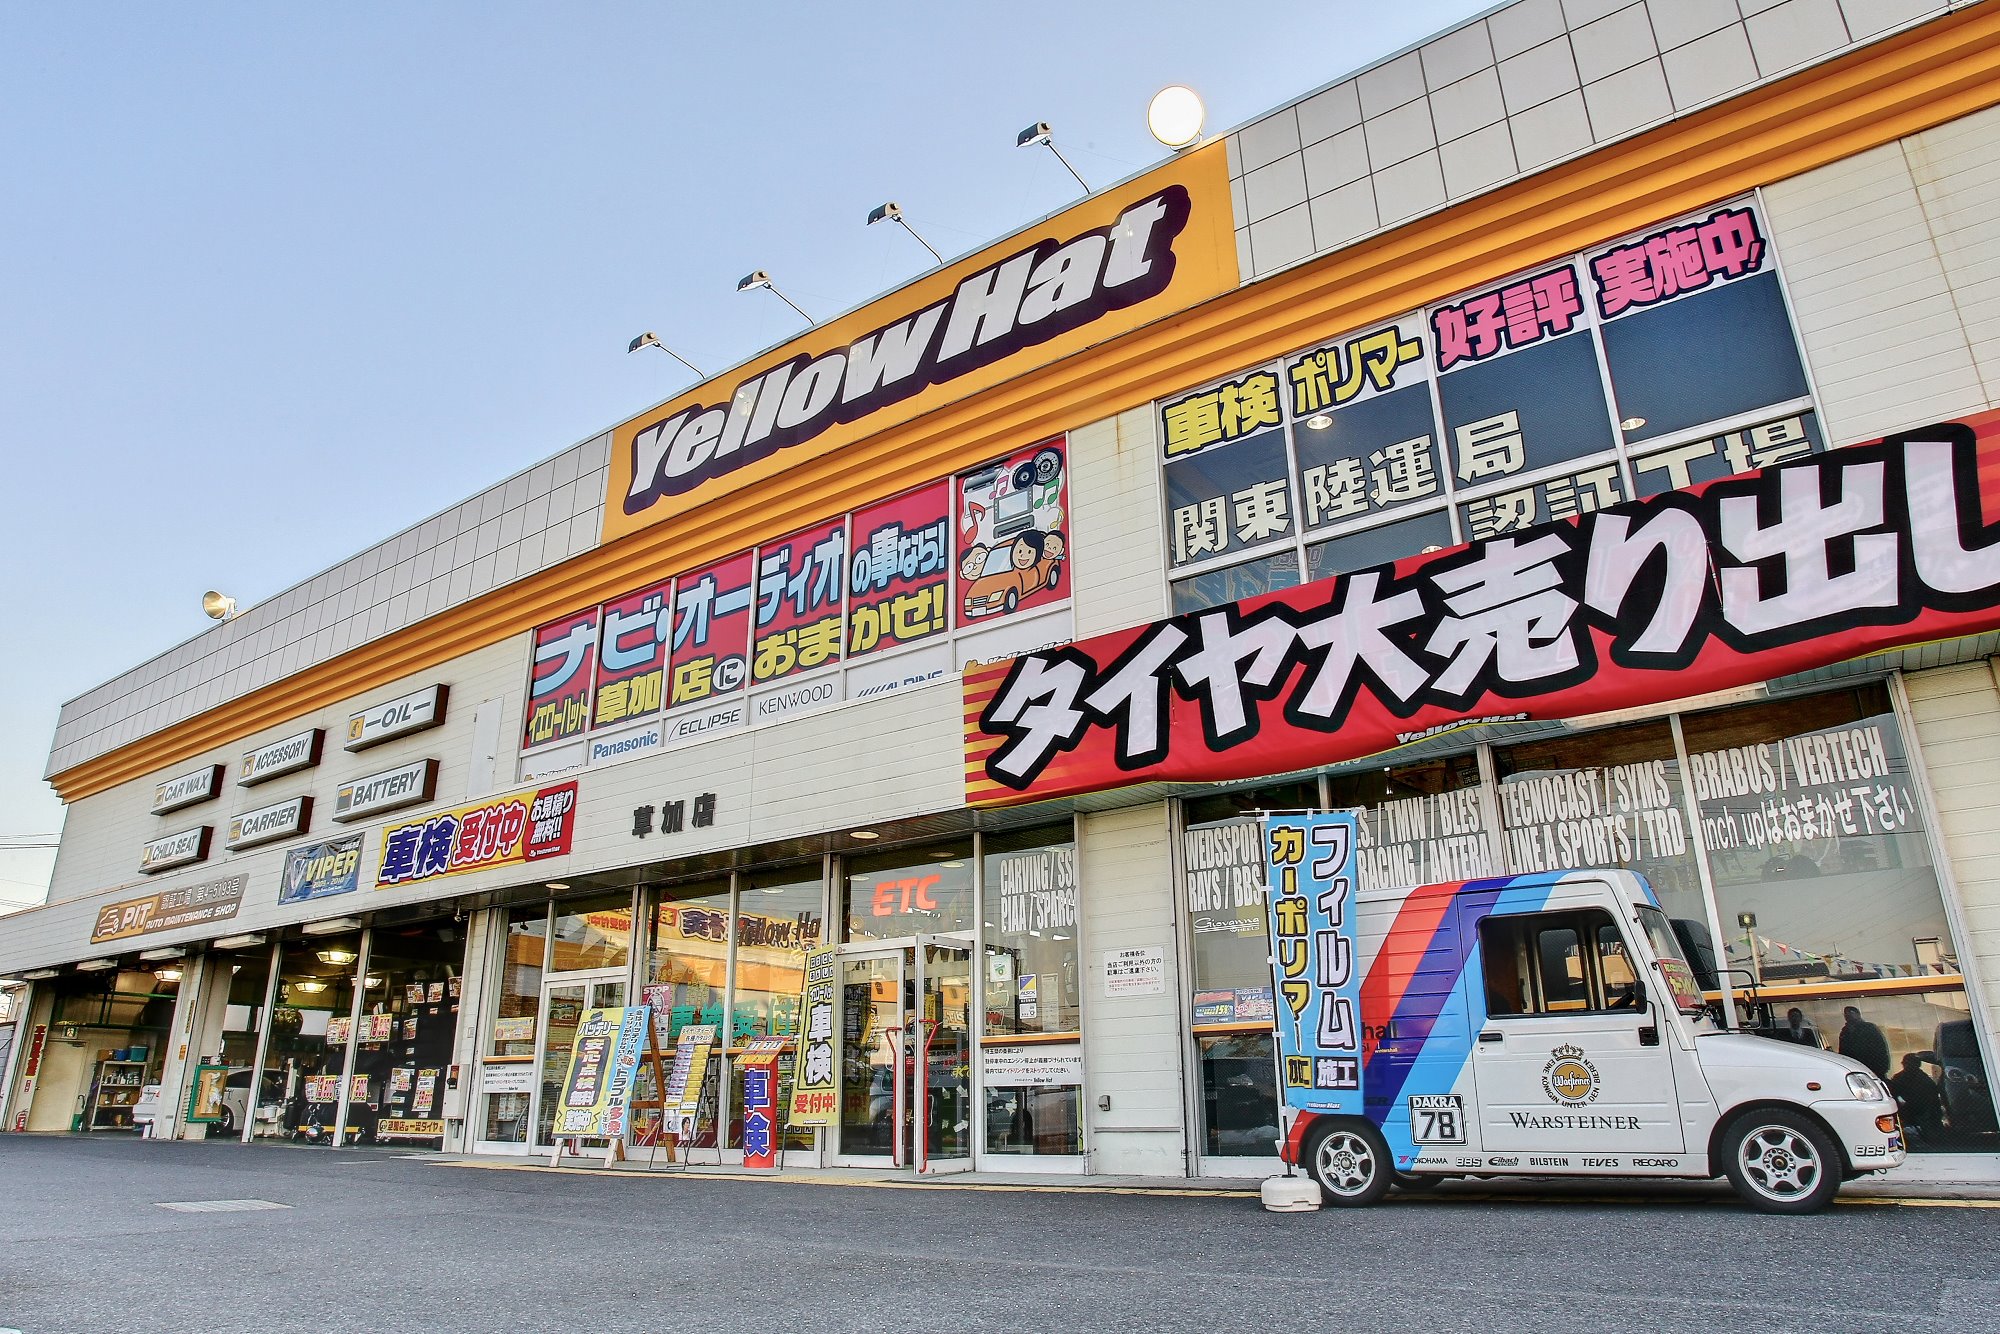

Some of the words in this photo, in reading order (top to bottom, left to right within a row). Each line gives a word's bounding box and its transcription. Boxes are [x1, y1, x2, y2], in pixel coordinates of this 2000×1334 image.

[1164, 374, 1281, 455] 車検
[1292, 330, 1422, 416] ポリマー
[1434, 268, 1582, 369] 好評
[988, 440, 2000, 778] タイヤ大売り出し
[380, 701, 412, 729] OIL
[758, 682, 833, 716] KENWOOD
[679, 708, 742, 736] ECLIPSE
[253, 738, 310, 773] ACCESSORY
[592, 729, 659, 760] Panasonic
[1690, 742, 1777, 802] BRABUS
[1786, 726, 1889, 789] VERTECH
[164, 780, 185, 801] CAR
[185, 772, 210, 796] WAX
[352, 768, 421, 807] BATTERY
[1498, 767, 1602, 828] TECNOCAST
[1613, 758, 1670, 811] SYMS
[242, 804, 298, 837] CARRIER
[530, 788, 574, 822] お見積り
[632, 792, 717, 838] 草加店
[1384, 795, 1427, 844] TMW
[151, 840, 175, 861] CHILD
[175, 834, 199, 856] SEAT
[1558, 811, 1633, 869] SPORTS
[1643, 807, 1687, 859] TRD
[305, 849, 359, 882] VIPER
[1000, 853, 1049, 896] CARVING
[1428, 833, 1494, 884] ANTERA
[871, 873, 943, 917] ETC
[1187, 869, 1222, 913] RAYS
[1232, 864, 1263, 908] BBS
[121, 902, 153, 930] PIT
[145, 917, 164, 930] AUTO
[164, 911, 213, 928] MAINTENANCE
[213, 902, 237, 918] SHOP
[1000, 894, 1028, 933] PIAA
[1194, 917, 1260, 929] Giovanna
[1270, 825, 1309, 1053] カーポリマー
[1311, 823, 1357, 1050] フィルム
[642, 985, 670, 995] STOP
[805, 1002, 833, 1086] 車検
[1316, 1057, 1358, 1089] 施工
[1412, 1096, 1458, 1109] DAKRA
[1419, 1110, 1457, 1140] 78
[1408, 1157, 1449, 1165] YOKOHAMA
[1455, 1156, 1483, 1168] BBS
[1529, 1157, 1569, 1167] BILSTEIN
[1632, 1158, 1679, 1168] RECARO
[1854, 1145, 1886, 1157] BBS
